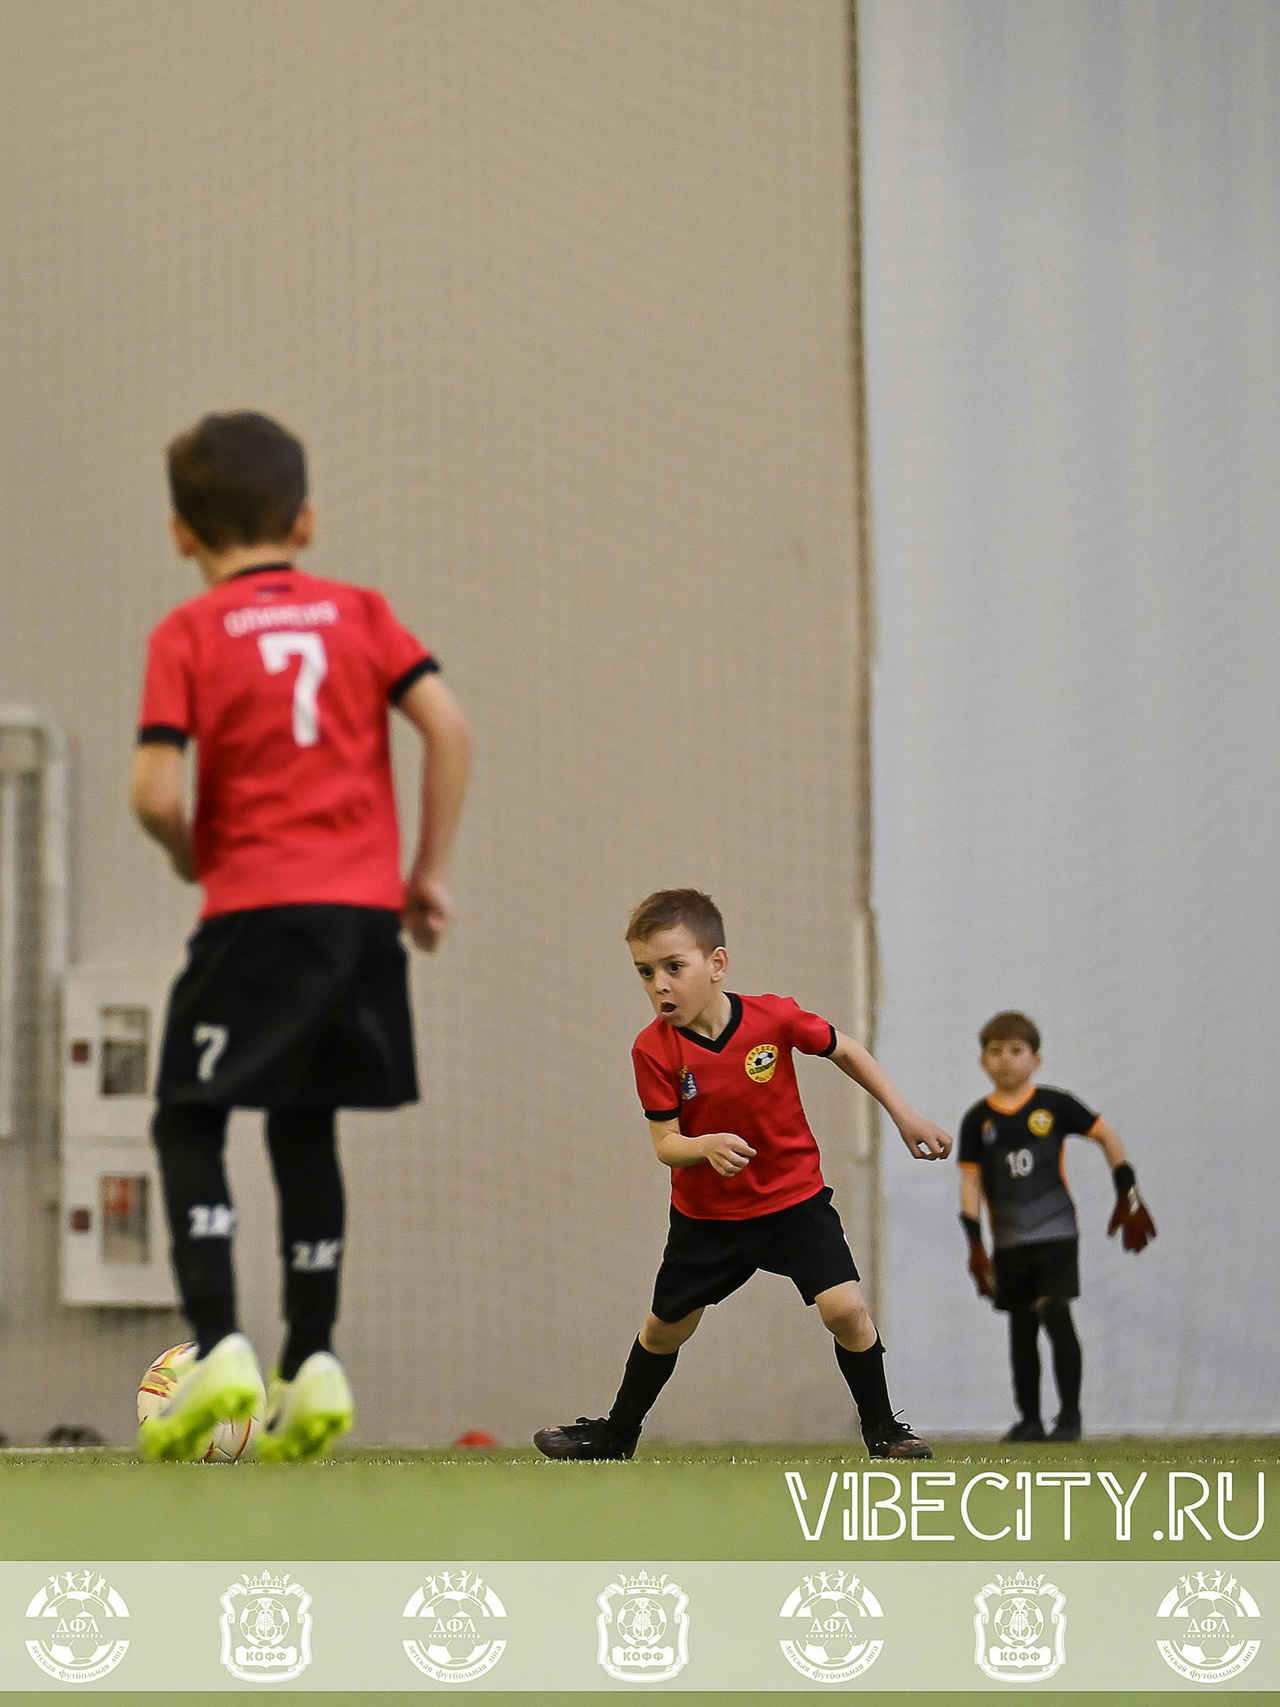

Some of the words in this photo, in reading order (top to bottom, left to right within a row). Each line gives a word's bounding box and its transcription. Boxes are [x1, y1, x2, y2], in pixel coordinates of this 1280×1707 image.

[258, 632, 328, 748] 7
[193, 1022, 230, 1082] 7
[1005, 1149, 1034, 1177] 10
